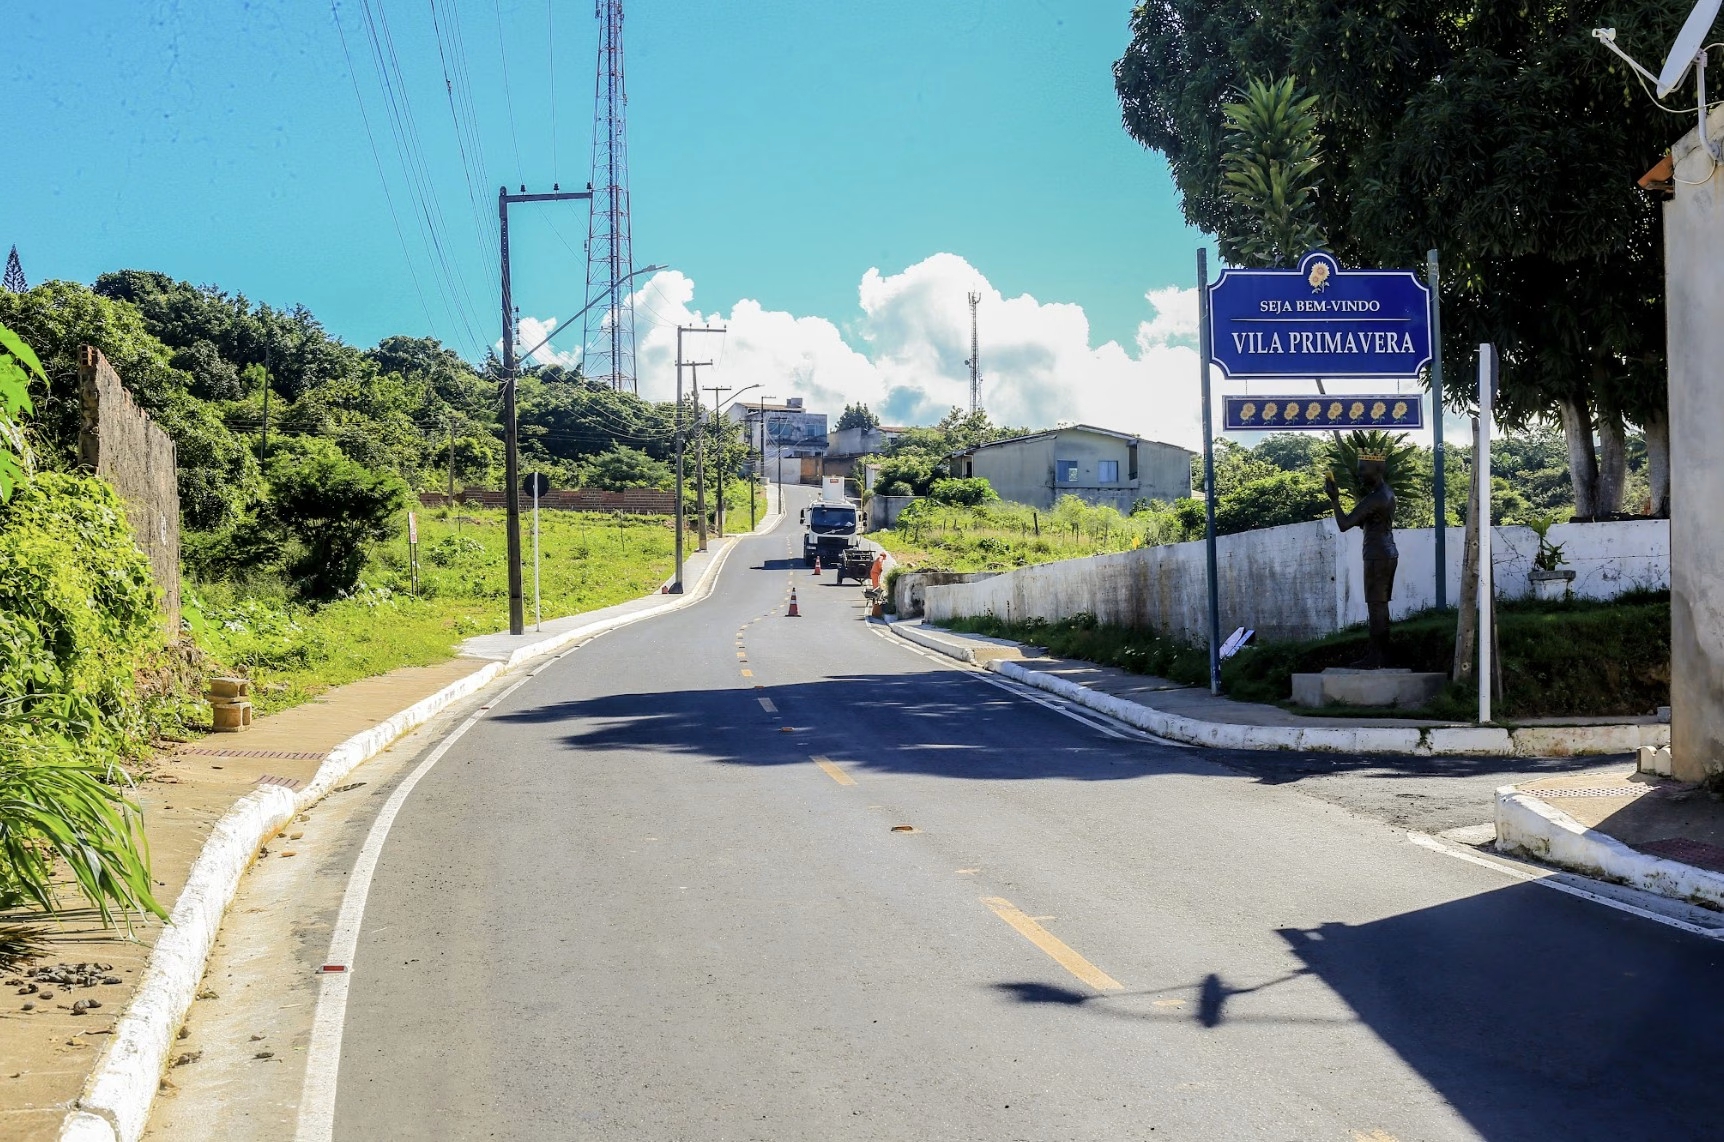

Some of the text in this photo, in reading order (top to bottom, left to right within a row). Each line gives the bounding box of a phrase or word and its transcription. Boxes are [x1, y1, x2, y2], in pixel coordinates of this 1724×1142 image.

[1260, 300, 1380, 315] SEJA BEM-VINDO
[1231, 331, 1415, 354] VILA PRIMAVERA
